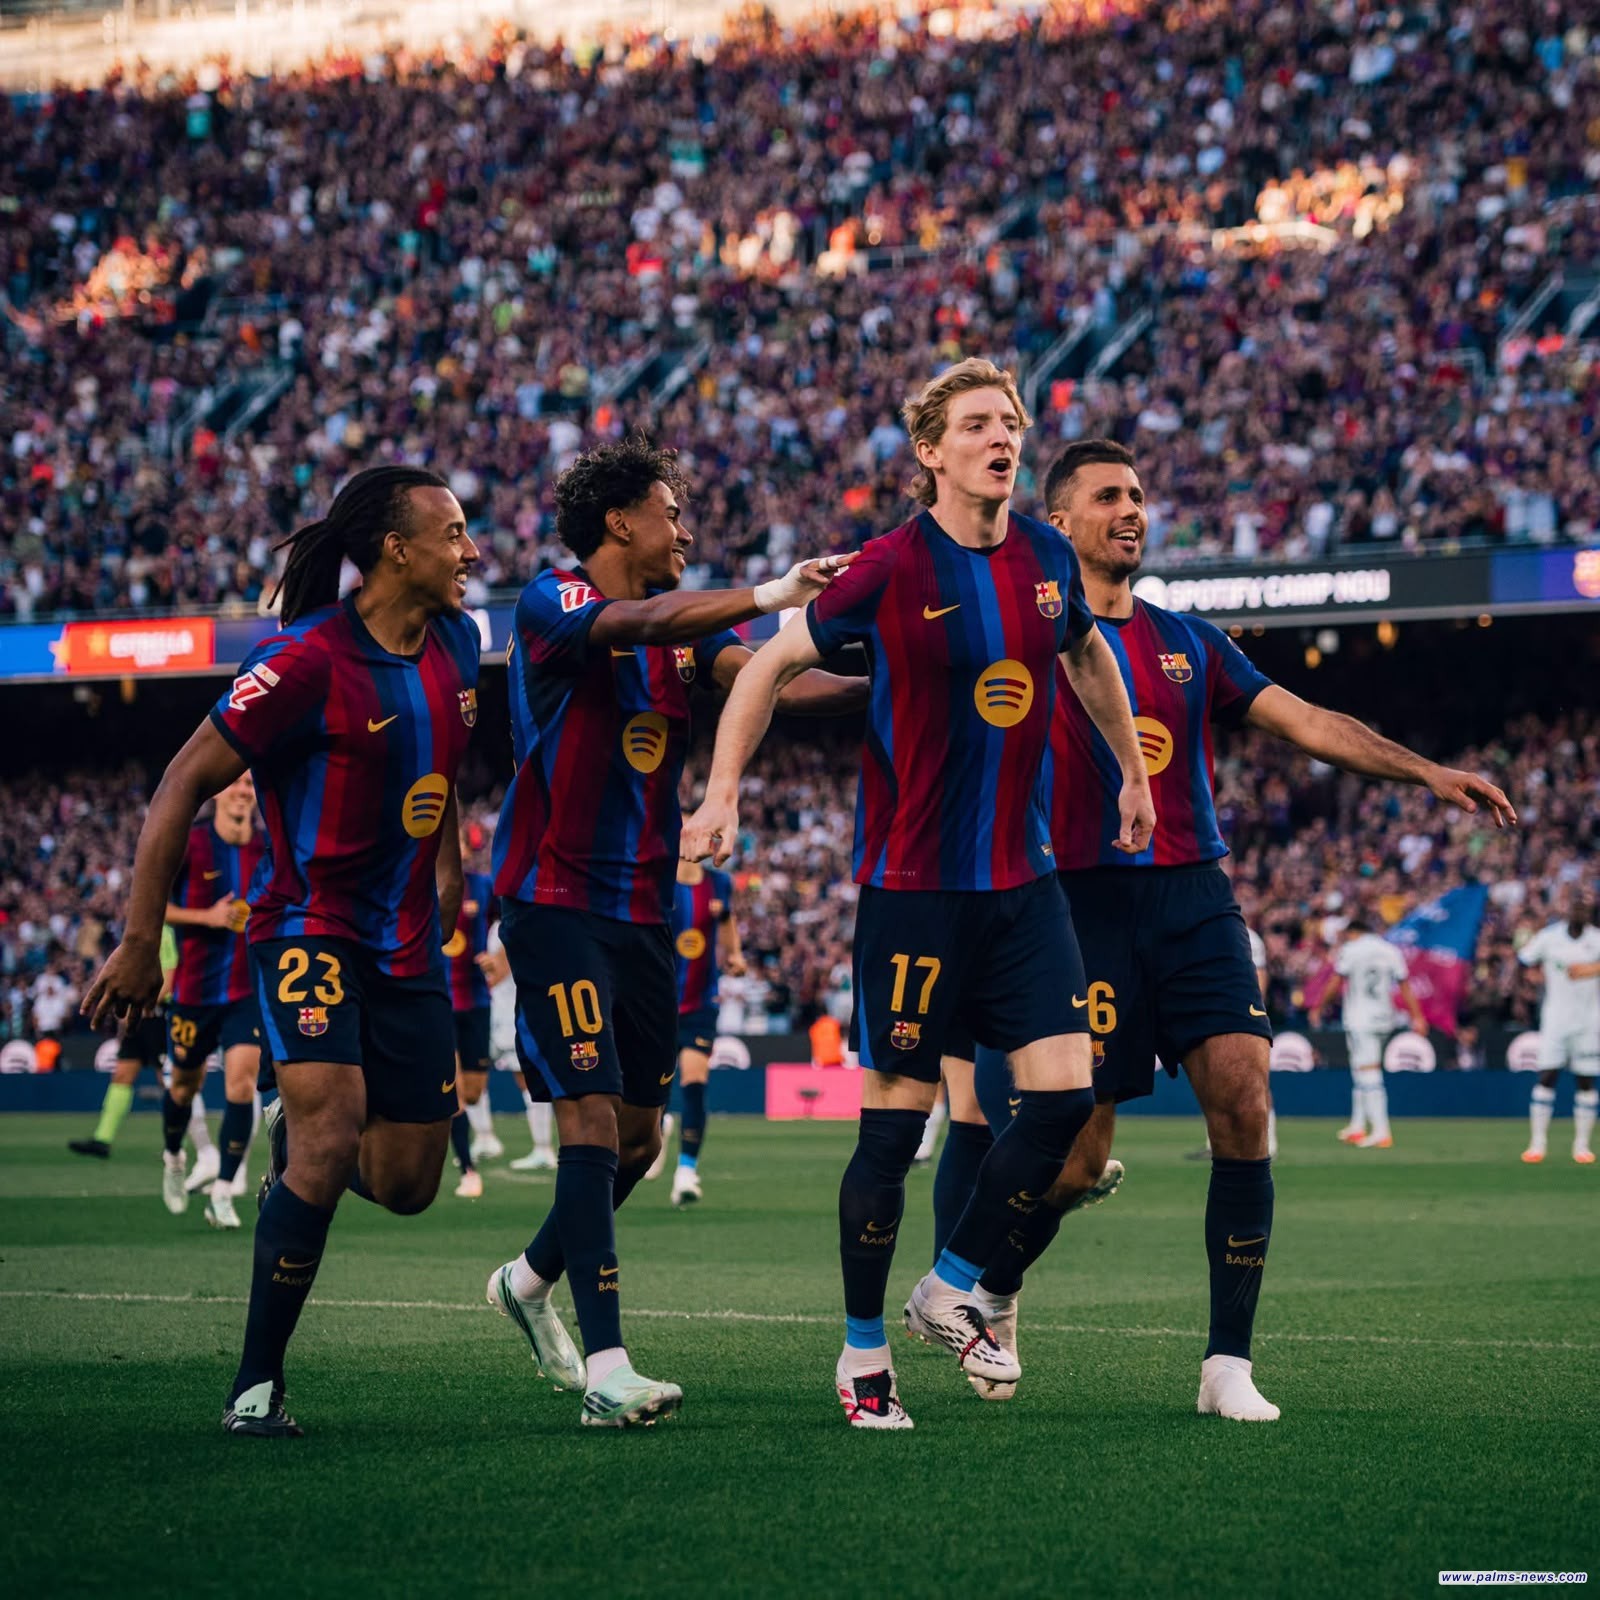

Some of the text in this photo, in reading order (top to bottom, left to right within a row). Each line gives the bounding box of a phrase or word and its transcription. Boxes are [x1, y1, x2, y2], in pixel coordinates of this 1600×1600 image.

[278, 947, 345, 1005] 23
[890, 953, 941, 1014] 17
[171, 1014, 197, 1047] 20
[547, 979, 603, 1037] 10
[1087, 980, 1117, 1034] 6
[272, 1271, 315, 1287] BAR
